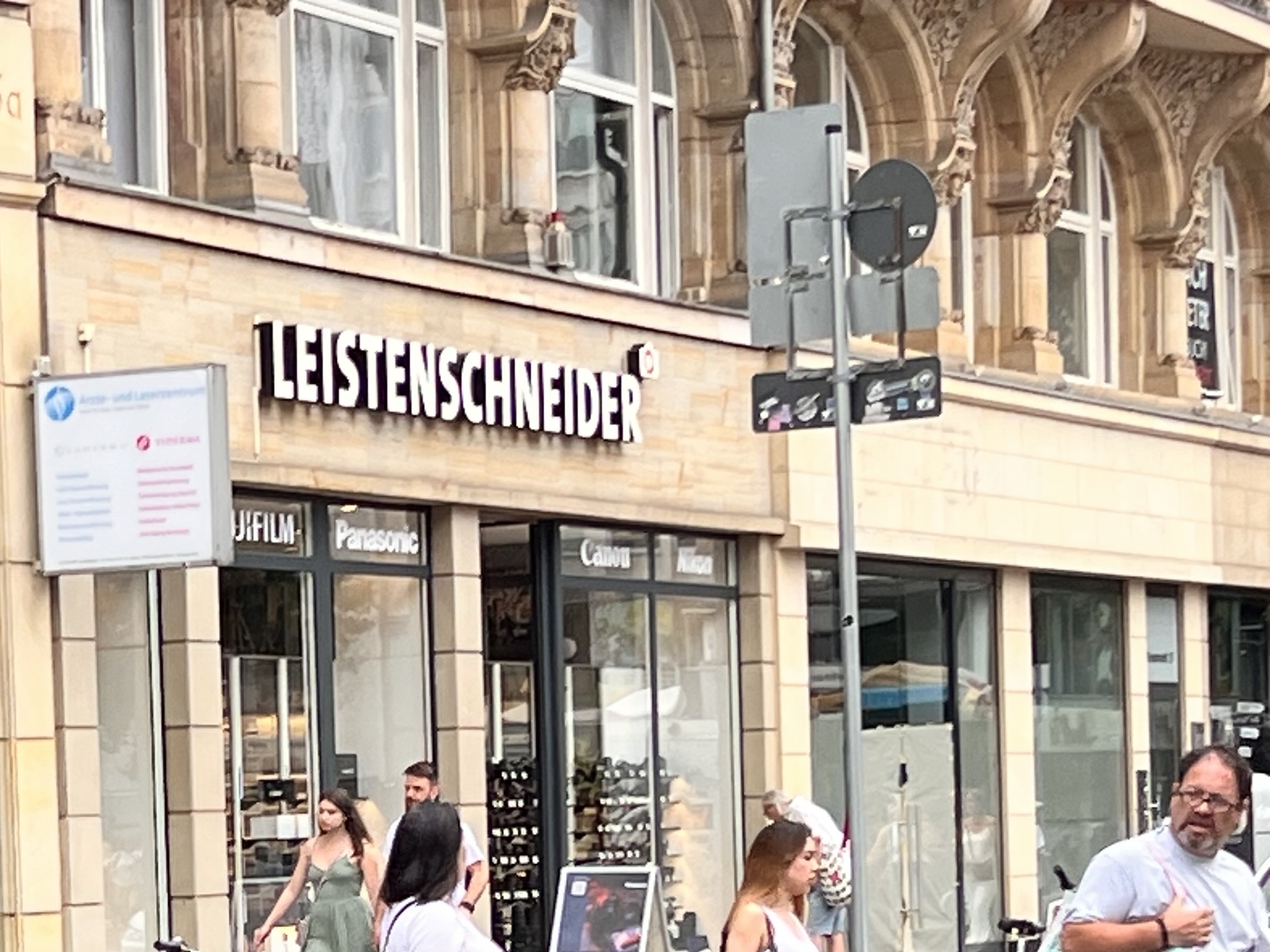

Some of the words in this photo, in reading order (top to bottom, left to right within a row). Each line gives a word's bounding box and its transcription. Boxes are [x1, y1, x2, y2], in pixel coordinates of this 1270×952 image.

[271, 320, 643, 443] LEISTENSCHNEIDER
[335, 519, 419, 554] Panasonic
[580, 539, 630, 568] Canon
